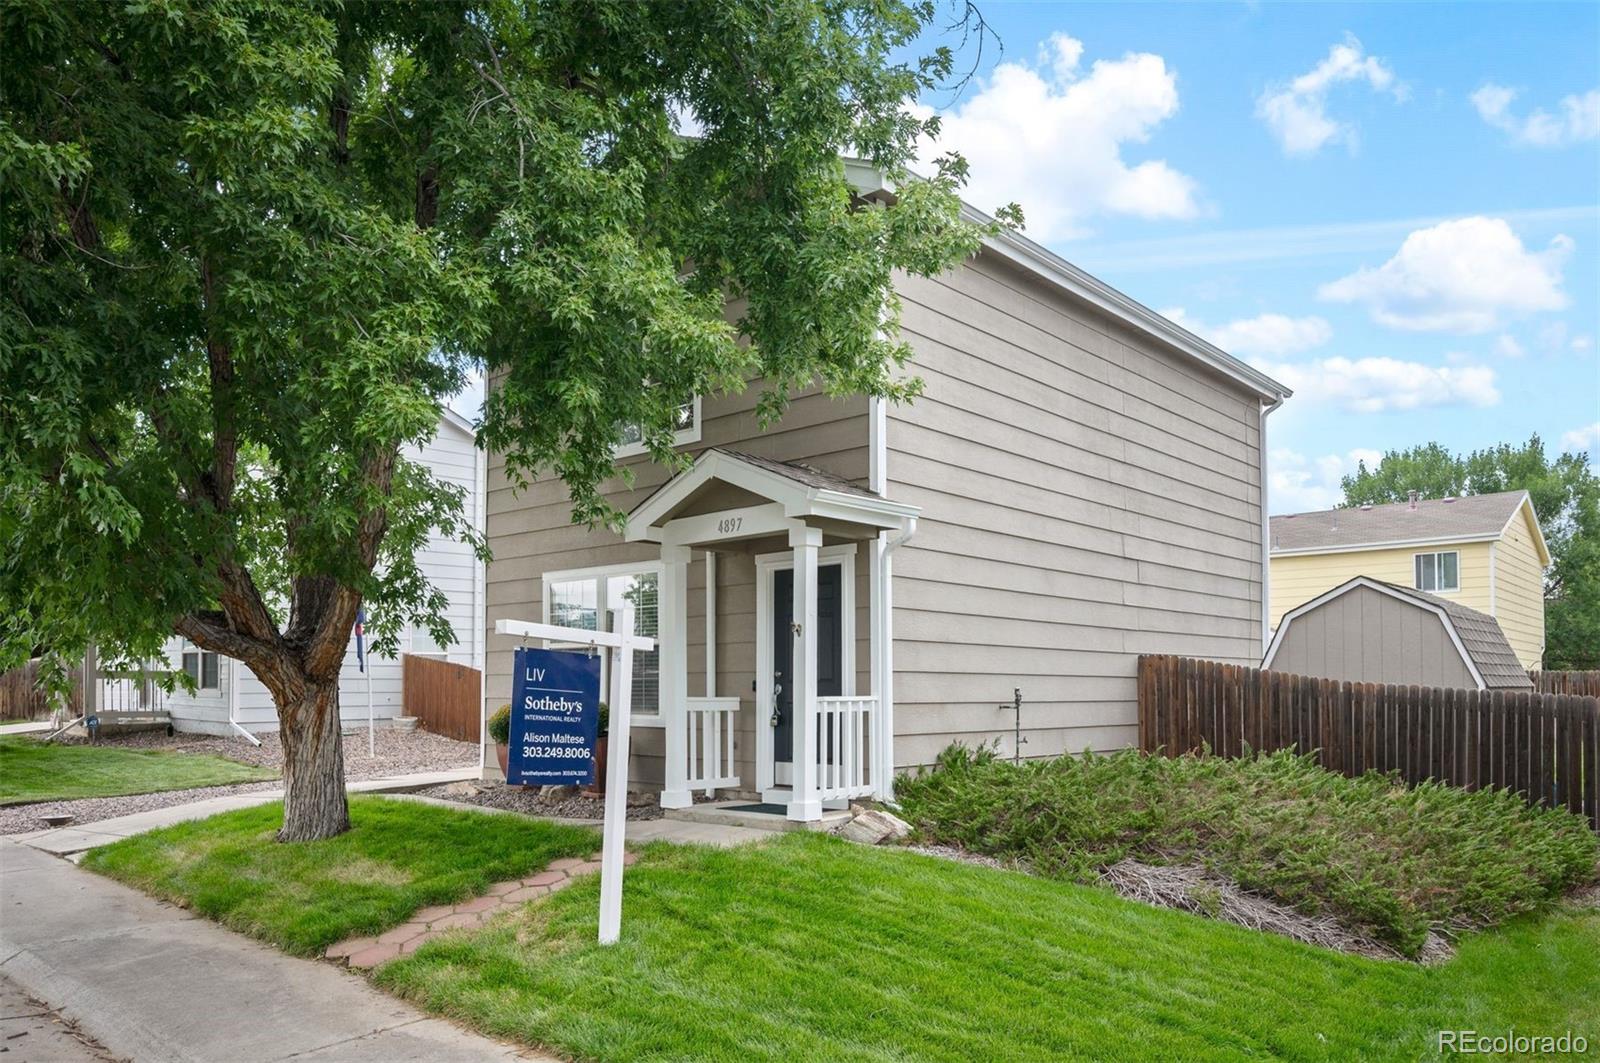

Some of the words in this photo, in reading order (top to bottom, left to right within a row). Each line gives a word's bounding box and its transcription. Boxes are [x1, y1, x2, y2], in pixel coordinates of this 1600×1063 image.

[718, 517, 743, 534] 4897
[526, 667, 545, 682] LIV
[525, 696, 583, 715] Sotheby's
[523, 732, 550, 743] Alison
[551, 733, 585, 745] Maltese
[523, 747, 591, 758] 303.249.8006
